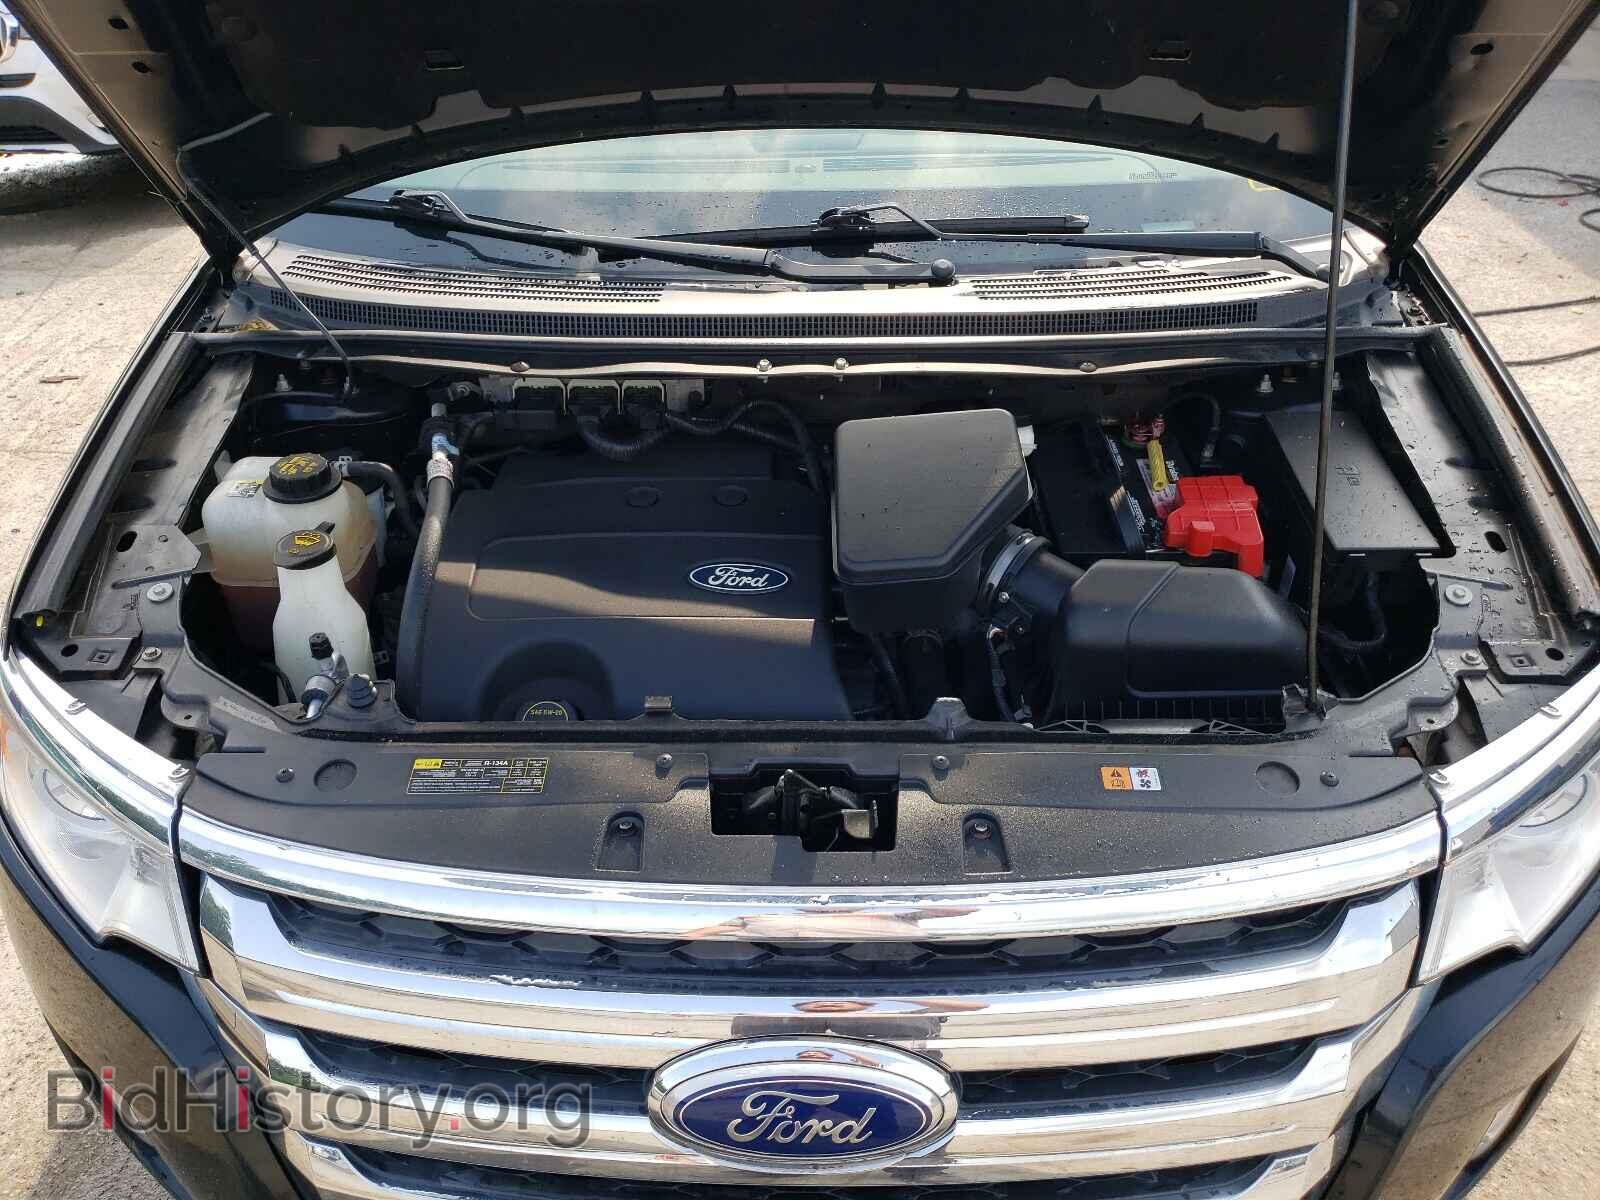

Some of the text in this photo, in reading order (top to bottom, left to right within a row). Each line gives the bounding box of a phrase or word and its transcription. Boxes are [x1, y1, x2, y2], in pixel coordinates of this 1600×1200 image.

[708, 566, 770, 587] Ford
[483, 759, 509, 767] R-134A
[727, 1090, 877, 1144] Ford
